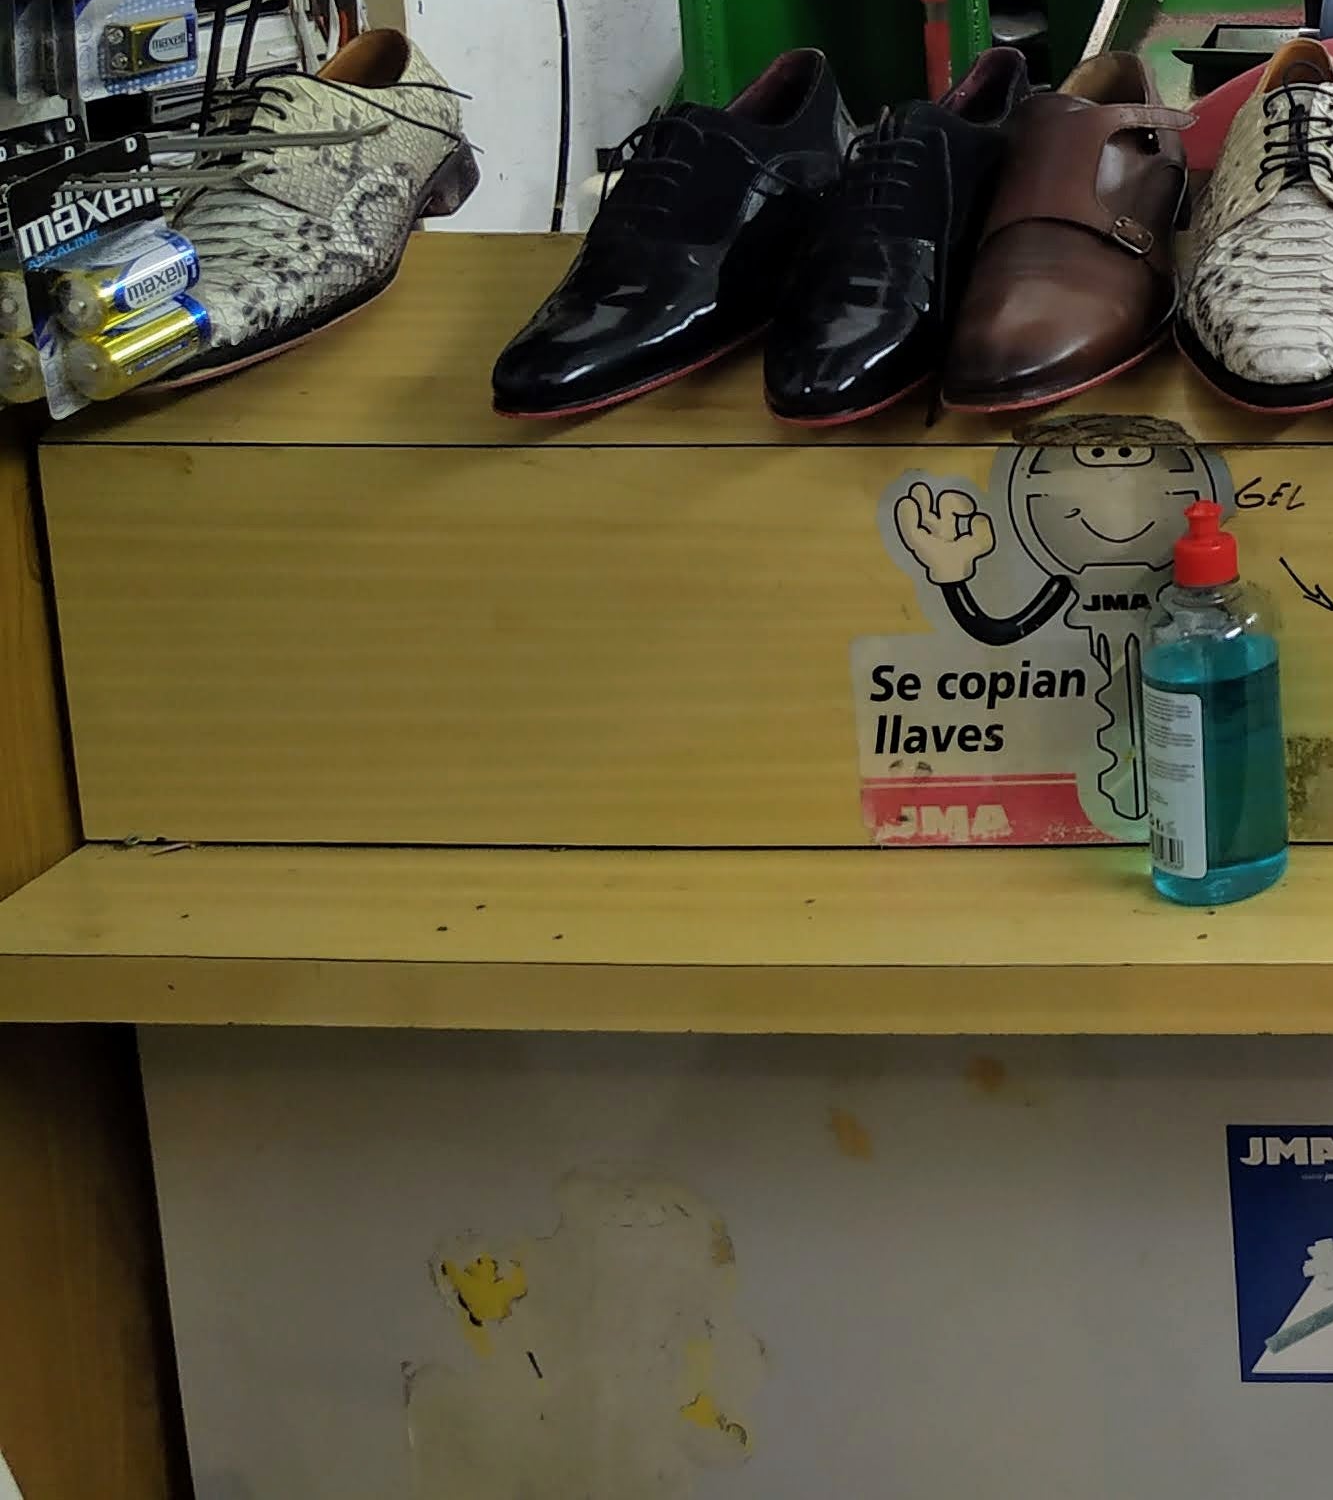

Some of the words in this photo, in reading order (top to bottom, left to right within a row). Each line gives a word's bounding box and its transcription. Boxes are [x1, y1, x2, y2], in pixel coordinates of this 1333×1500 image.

[151, 30, 187, 52] maxell
[65, 116, 76, 132] D
[125, 136, 137, 153] D
[18, 172, 156, 259] maxell
[26, 229, 99, 271] ALKALINE
[127, 260, 187, 303] maxell
[1234, 477, 1306, 510] GEL
[1083, 593, 1150, 612] JMA
[870, 663, 921, 703] Se
[936, 659, 1087, 710] copian
[874, 714, 1005, 755] llaves
[876, 803, 1013, 842] JMA
